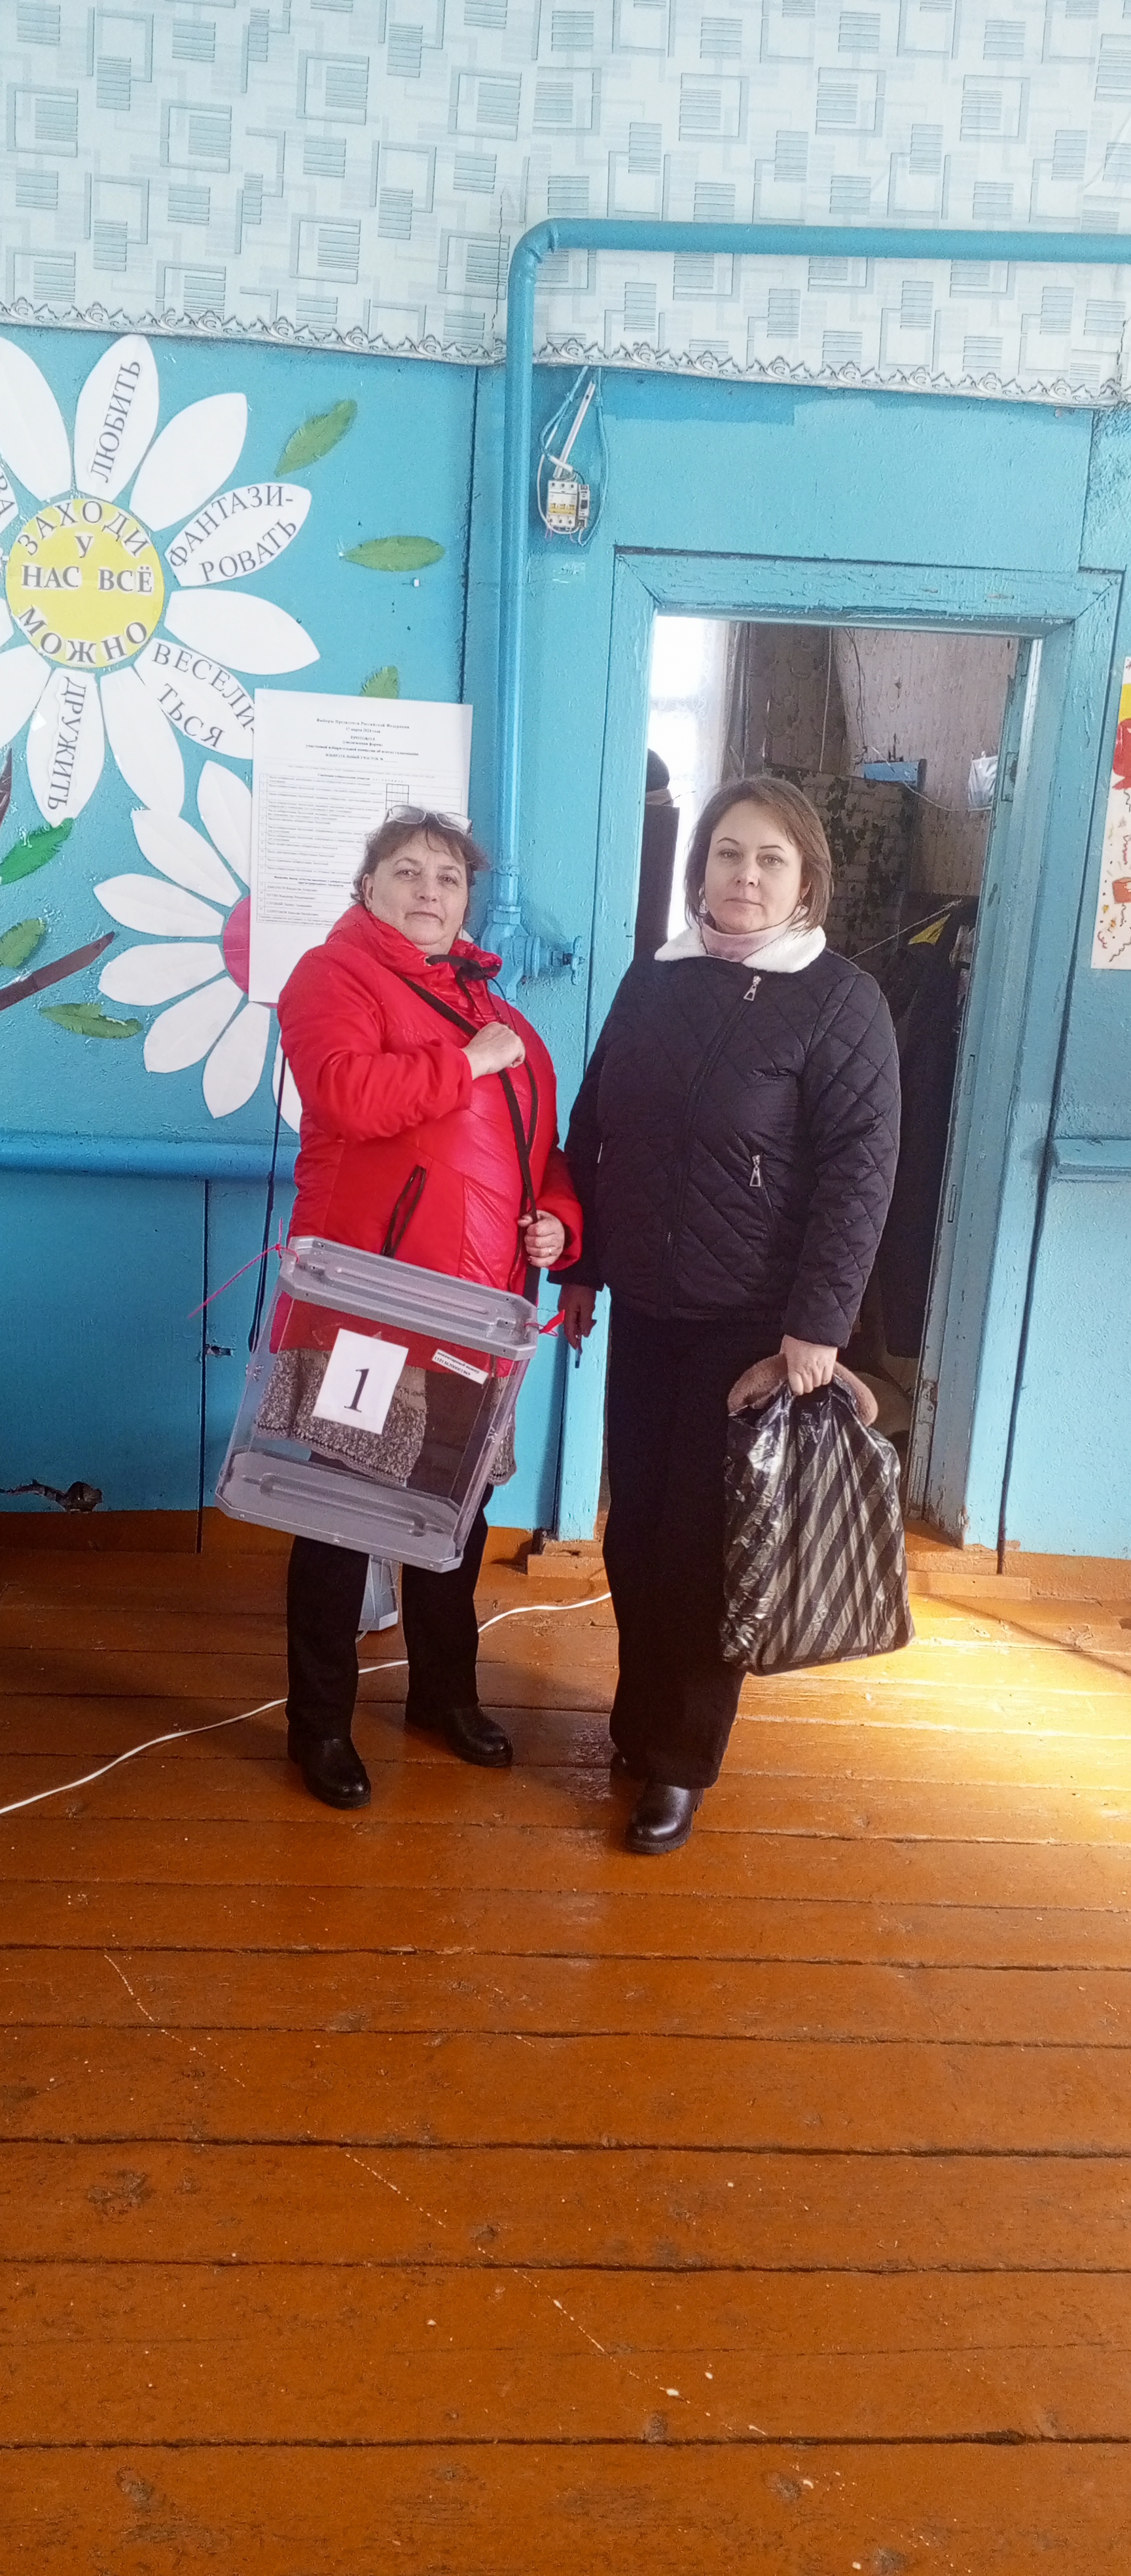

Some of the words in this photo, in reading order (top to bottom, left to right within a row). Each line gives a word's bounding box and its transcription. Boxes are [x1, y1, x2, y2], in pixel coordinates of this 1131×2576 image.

[90, 361, 141, 483] ЛЮБИТЬ
[0, 472, 15, 518] РА
[17, 501, 150, 557] ЗАХОДИ
[74, 535, 94, 558] У
[170, 485, 294, 568] ФАНТАЗИ-
[198, 519, 297, 582] РОВАТЬ
[21, 565, 80, 588] НАС
[98, 566, 153, 593] ВСЁ
[18, 605, 147, 664] МОЖНО
[48, 676, 87, 810] ДРУЖИТЬ
[156, 683, 226, 749] ТЬСЯ
[344, 1368, 370, 1414] 1
